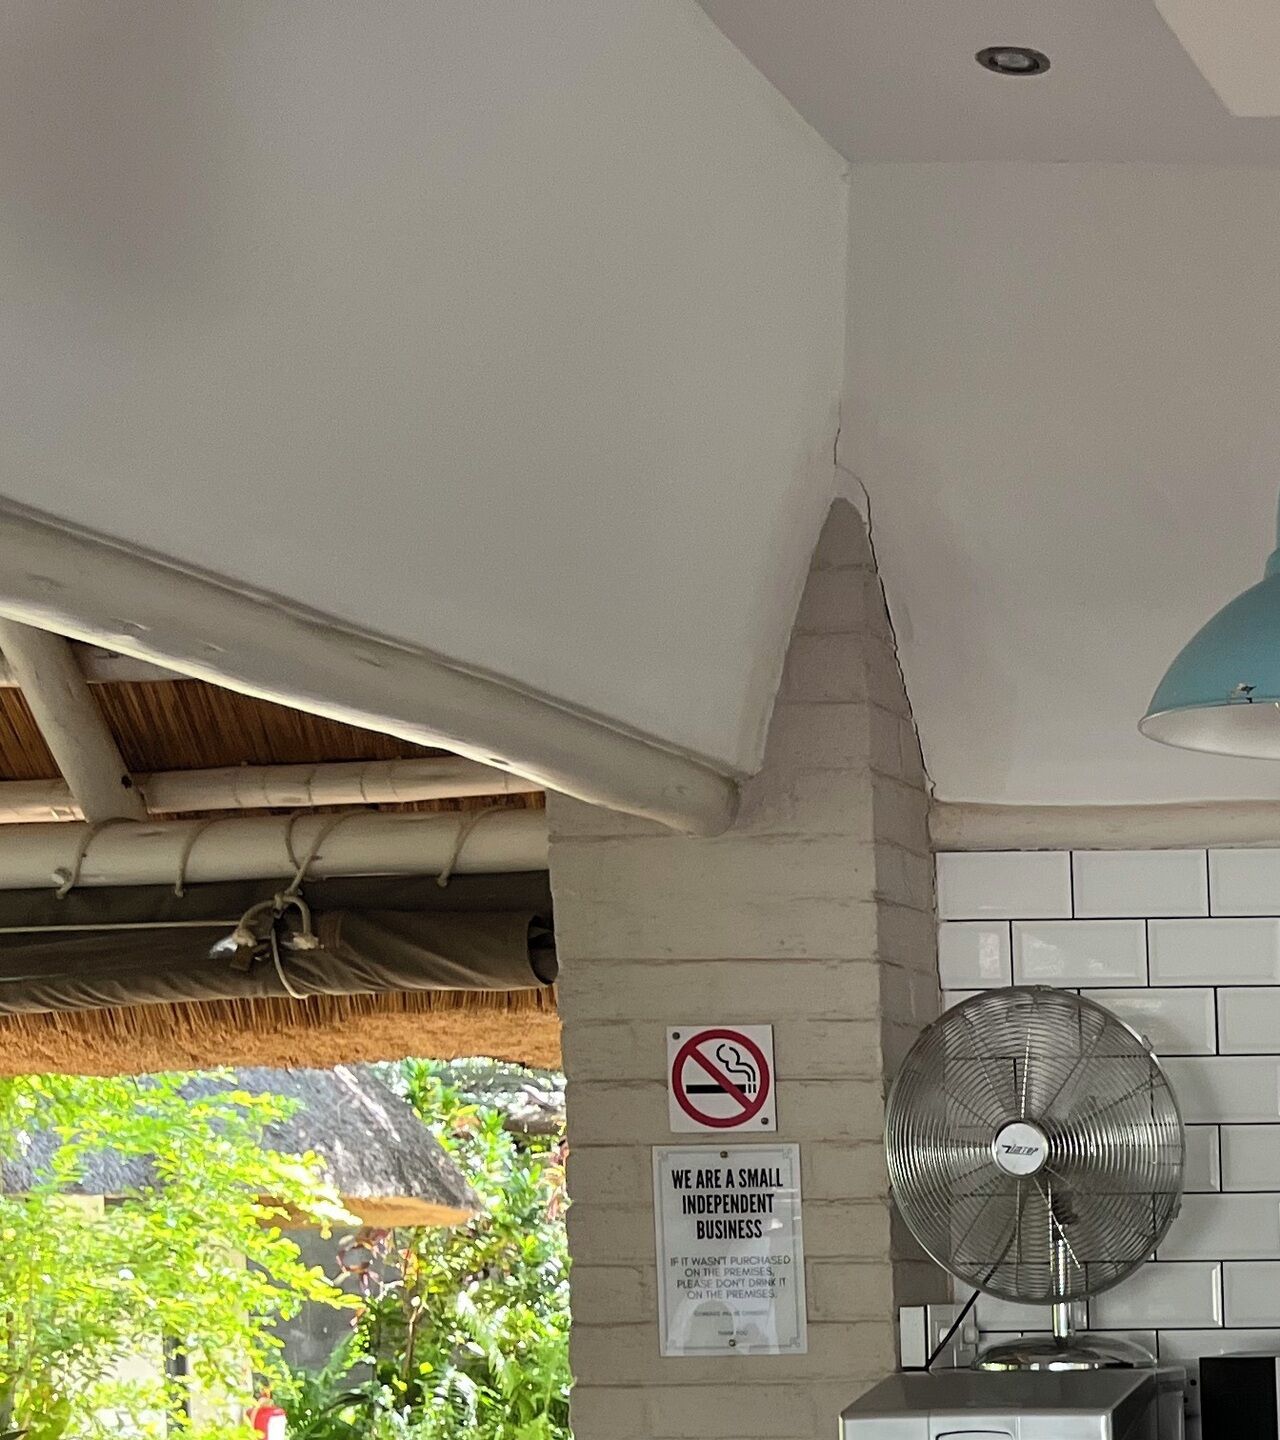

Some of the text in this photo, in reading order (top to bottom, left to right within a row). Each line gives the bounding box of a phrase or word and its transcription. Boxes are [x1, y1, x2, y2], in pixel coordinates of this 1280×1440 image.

[671, 1167, 783, 1189] WE ARE A SMALL
[682, 1193, 774, 1214] INDEPENDENT
[696, 1218, 762, 1239] BUSINESS
[670, 1255, 791, 1267] IF IT WASN'T PURCHASED
[684, 1268, 700, 1277] ON
[703, 1267, 720, 1277] THE
[676, 1277, 786, 1289] PLEASE DON'T DRINK IT
[687, 1290, 702, 1300] ON
[706, 1290, 722, 1299] THE
